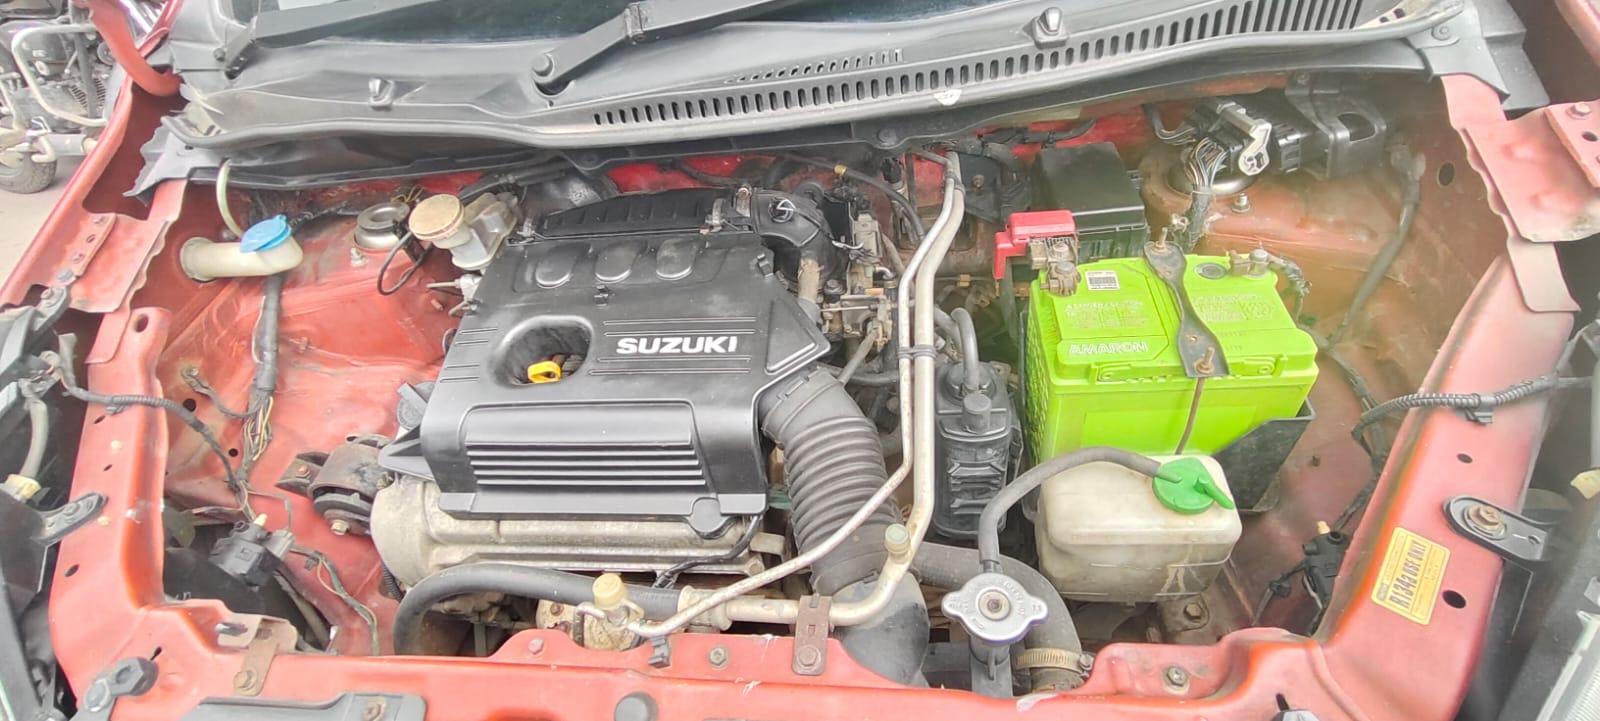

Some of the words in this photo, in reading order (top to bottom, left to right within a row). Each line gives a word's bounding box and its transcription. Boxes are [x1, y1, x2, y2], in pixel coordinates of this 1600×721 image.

[616, 336, 738, 354] SUZUKI
[1069, 341, 1148, 355] AMARON
[1389, 574, 1418, 609] R134a
